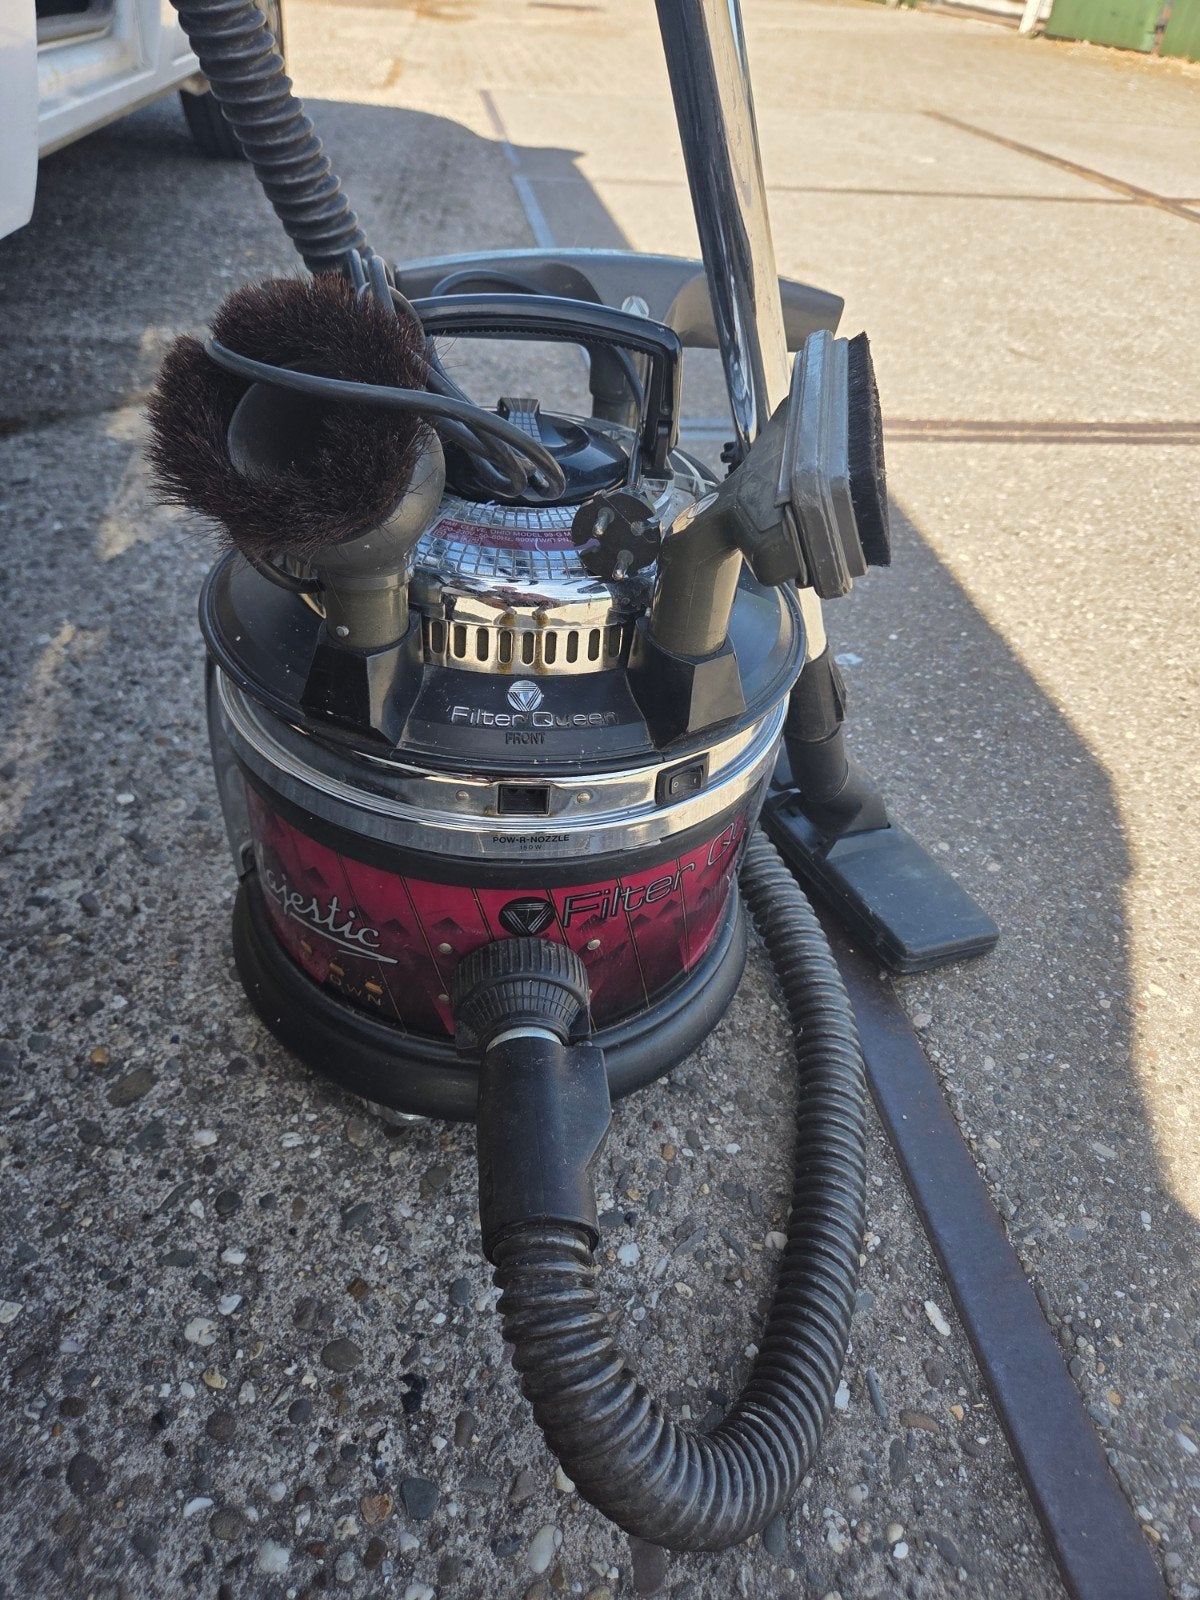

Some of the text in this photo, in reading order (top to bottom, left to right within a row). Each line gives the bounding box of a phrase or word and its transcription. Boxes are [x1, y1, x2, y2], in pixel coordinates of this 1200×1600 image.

[450, 705, 619, 728] Filter Queen
[505, 732, 545, 745] FRONT
[492, 834, 570, 844] POW-R-NOZZLE
[563, 861, 695, 928] Filter
[266, 868, 381, 948] ajestic
